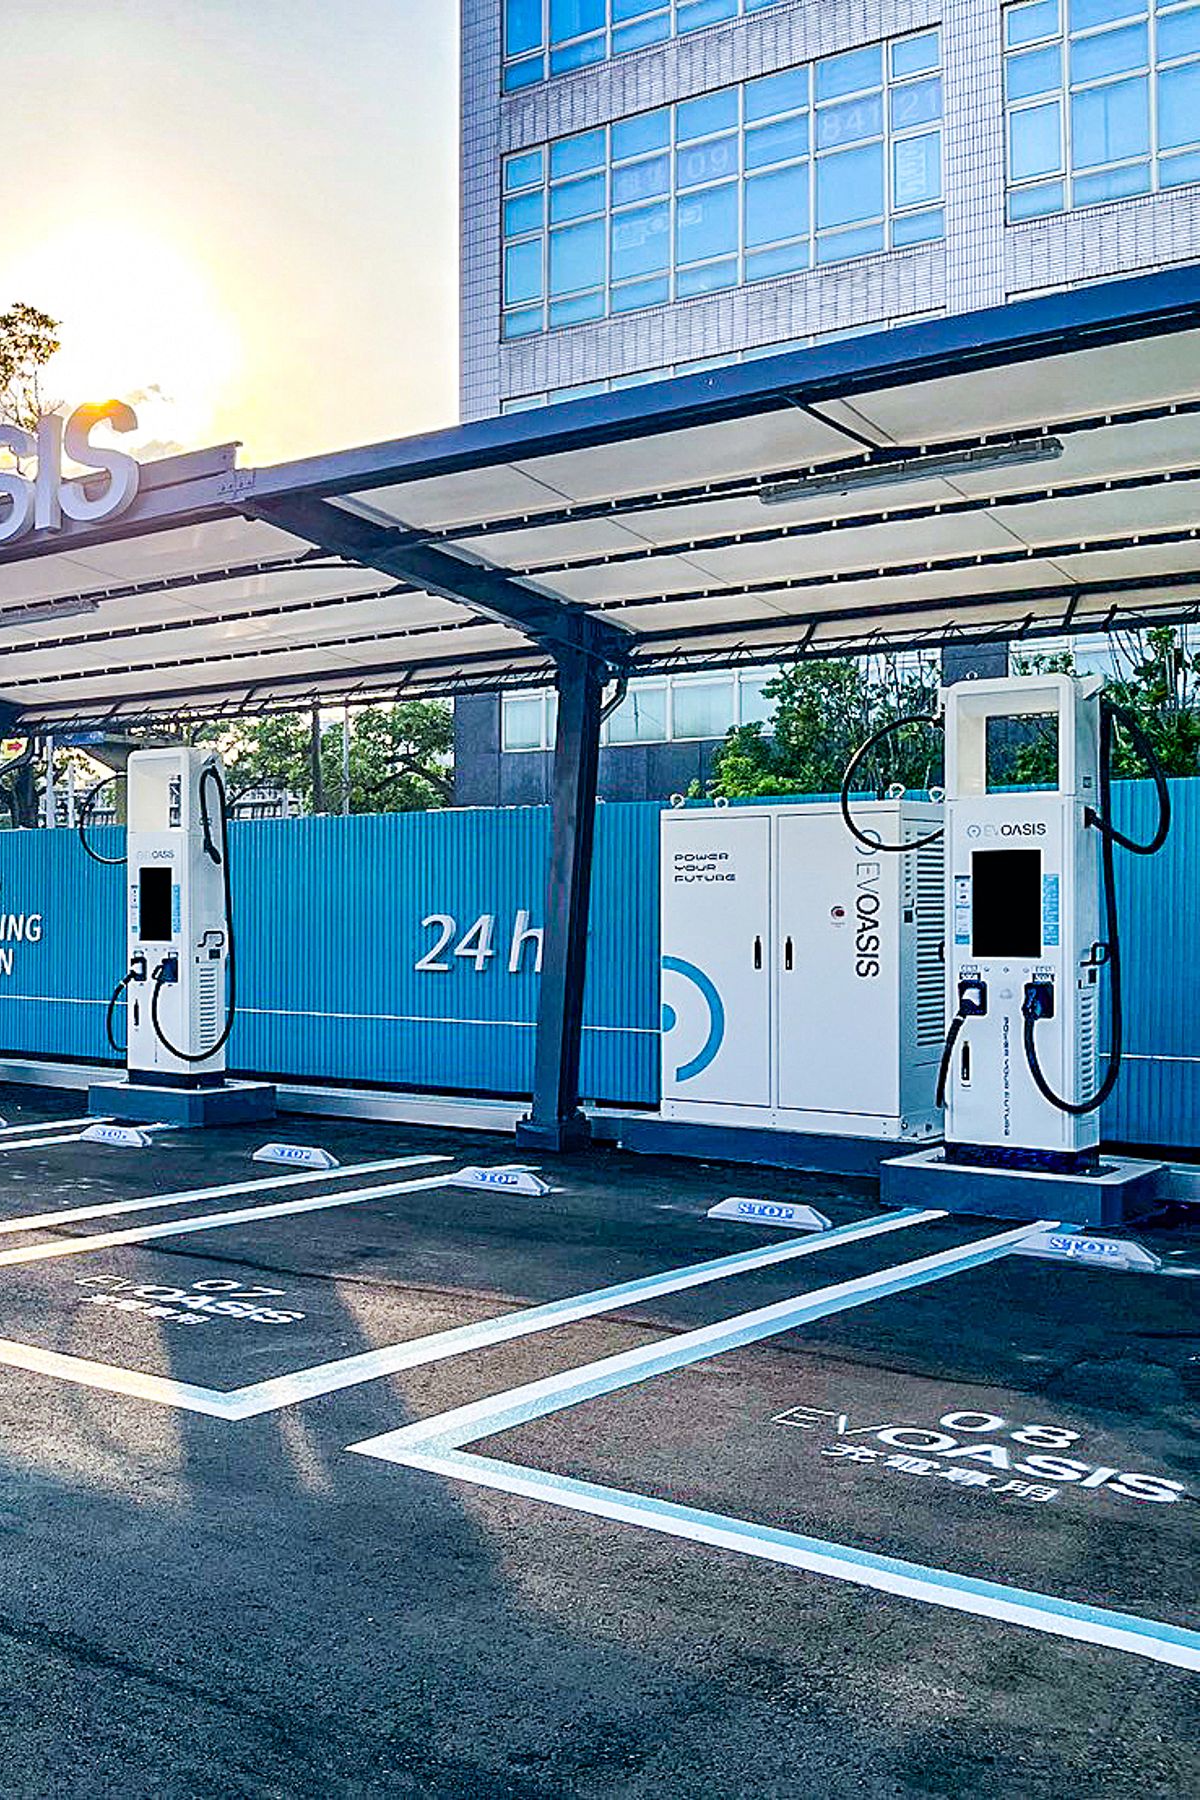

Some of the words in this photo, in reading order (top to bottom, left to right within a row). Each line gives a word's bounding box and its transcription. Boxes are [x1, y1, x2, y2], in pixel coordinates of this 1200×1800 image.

[674, 852, 730, 862] POWER
[674, 863, 717, 872] YOUR
[674, 873, 737, 882] FUTURE
[855, 862, 880, 979] EVOASIS
[473, 1171, 518, 1185] STOP
[738, 1203, 794, 1219] STOP
[1049, 1238, 1119, 1256] STOP
[938, 1410, 1081, 1449] 08
[770, 1405, 1186, 1503] EVOASIS
